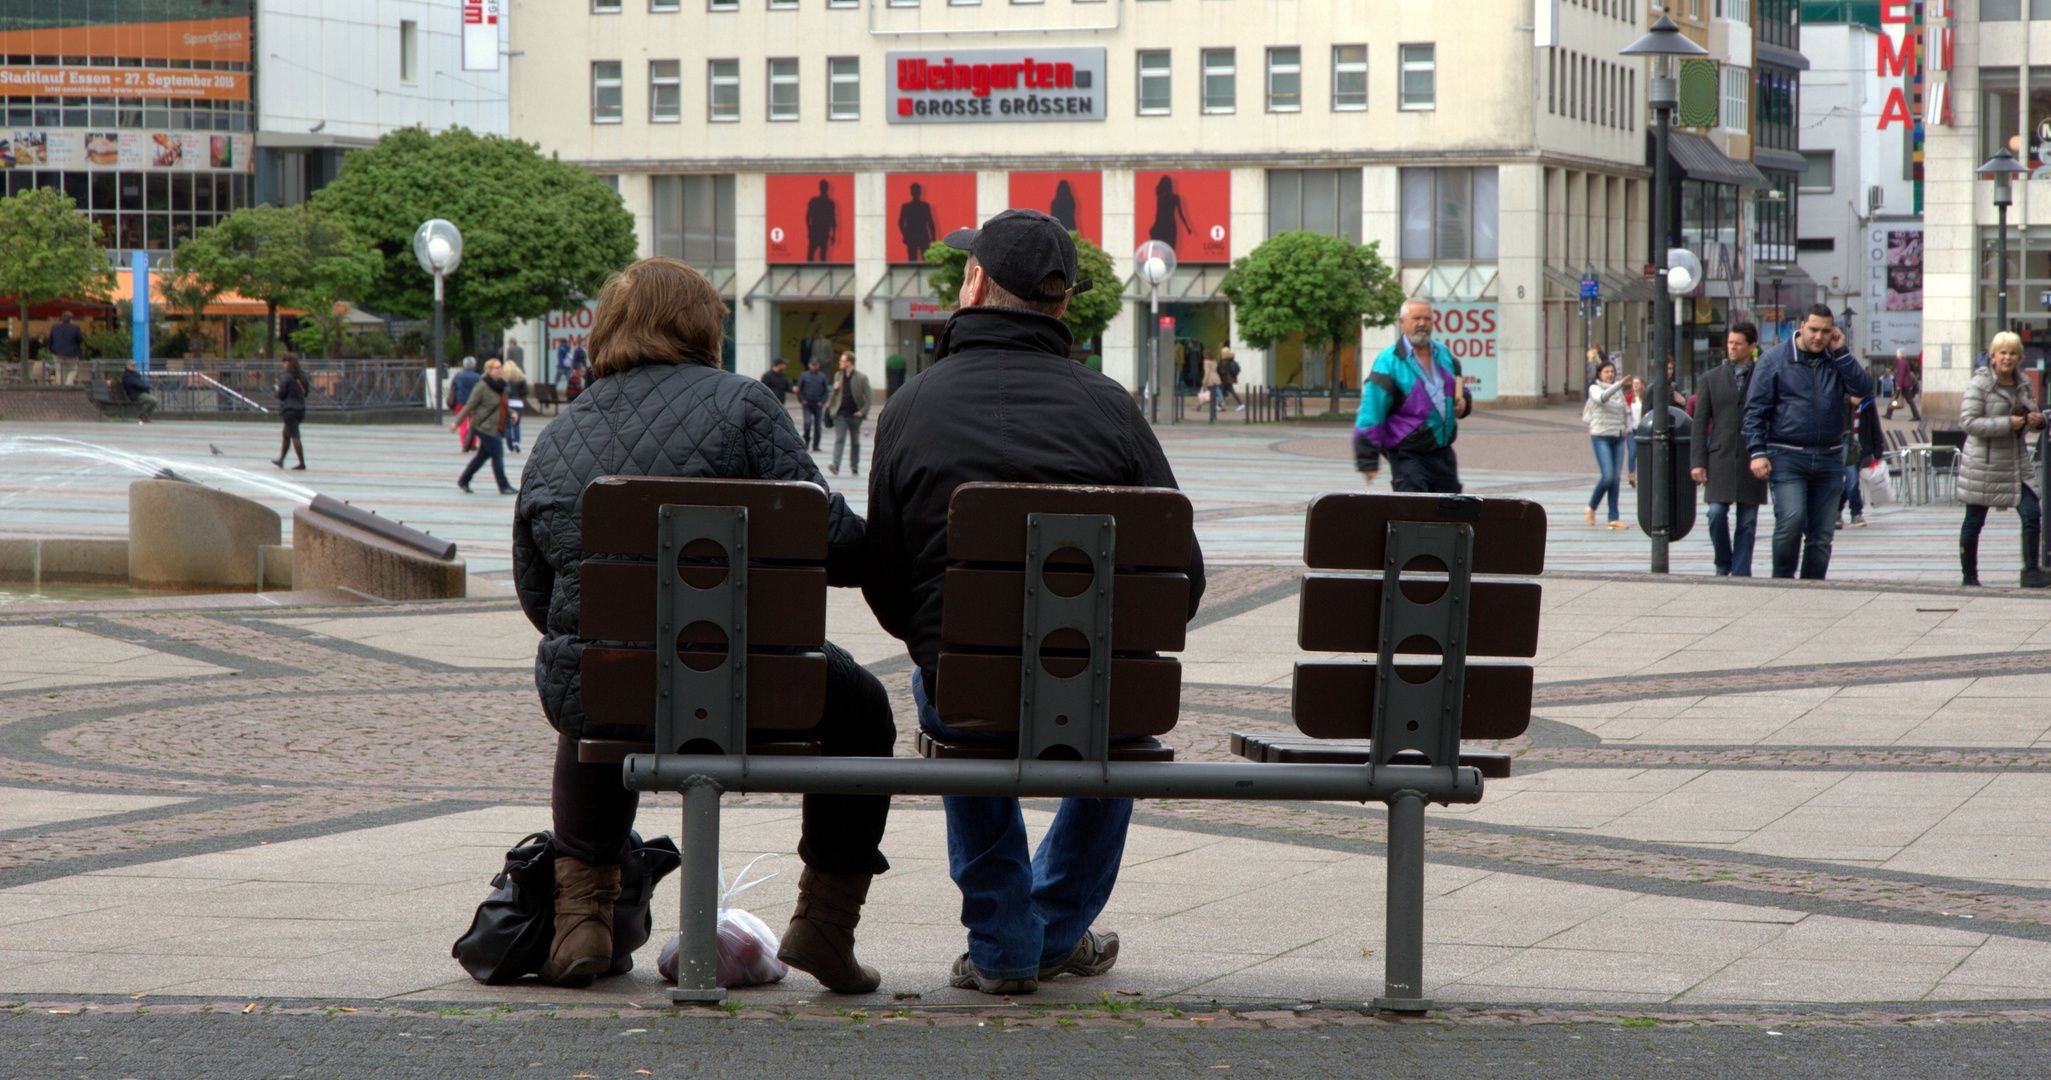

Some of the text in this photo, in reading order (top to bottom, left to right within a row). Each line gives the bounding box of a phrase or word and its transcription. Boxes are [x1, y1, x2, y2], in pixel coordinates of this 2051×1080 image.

[0, 70, 66, 84] Stadtlauf
[69, 71, 111, 84] Essen
[124, 72, 144, 85] 27.
[147, 72, 212, 88] September
[214, 75, 235, 88] 2015
[897, 57, 1074, 97] Weingarten
[915, 94, 1092, 116] GROSSE GRÖSSEN
[1871, 229, 1884, 352] COLLIER
[1432, 308, 1497, 334] ROSS
